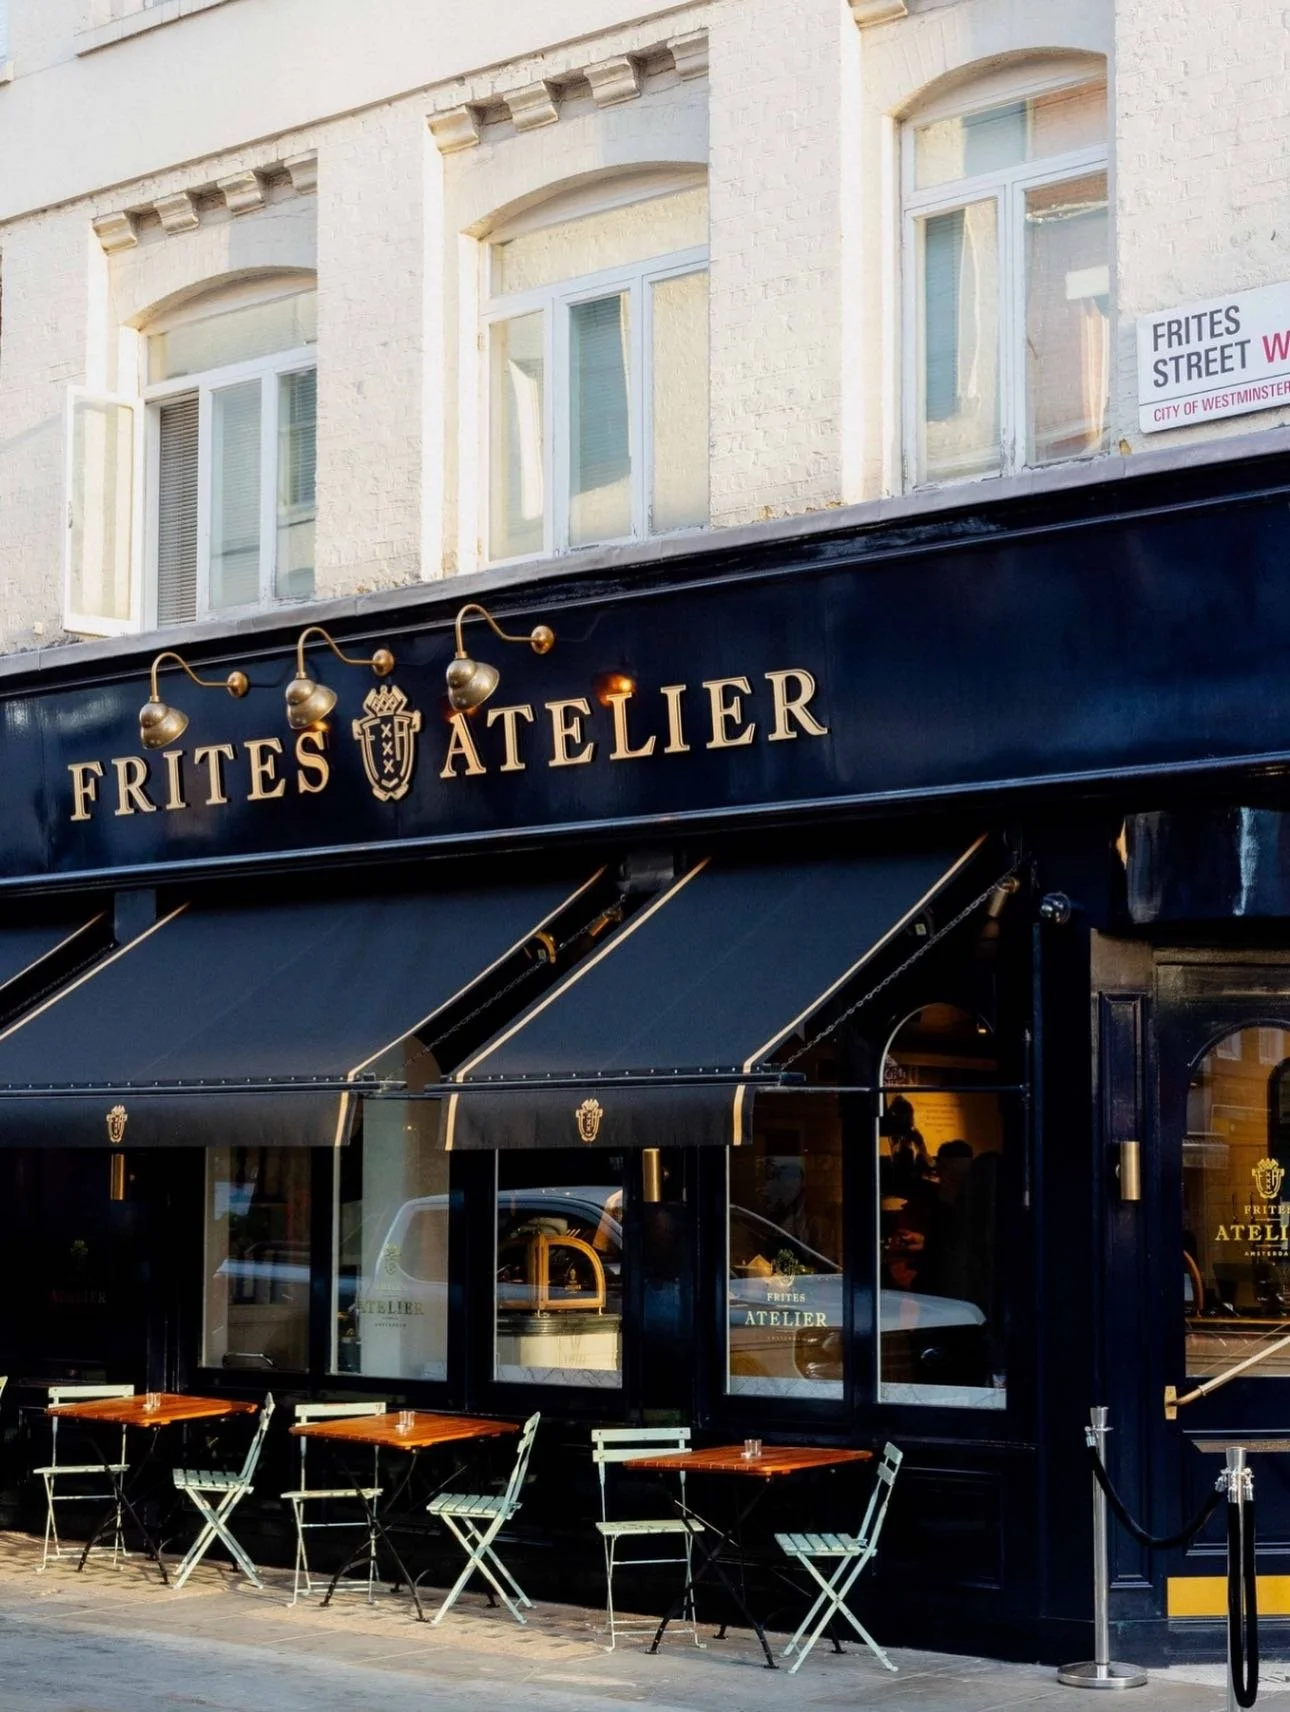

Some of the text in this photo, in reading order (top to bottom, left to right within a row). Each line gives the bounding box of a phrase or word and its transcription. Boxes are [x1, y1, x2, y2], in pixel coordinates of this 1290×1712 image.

[1152, 305, 1241, 352] FRITES
[1153, 339, 1251, 388] STREET
[1154, 380, 1290, 422] CITY OF WESTMINSTER
[67, 668, 829, 821] FRITES ATELIER
[1215, 1224, 1289, 1241] ATELI
[767, 1292, 806, 1303] FRITES
[744, 1310, 829, 1328] ATELIER
